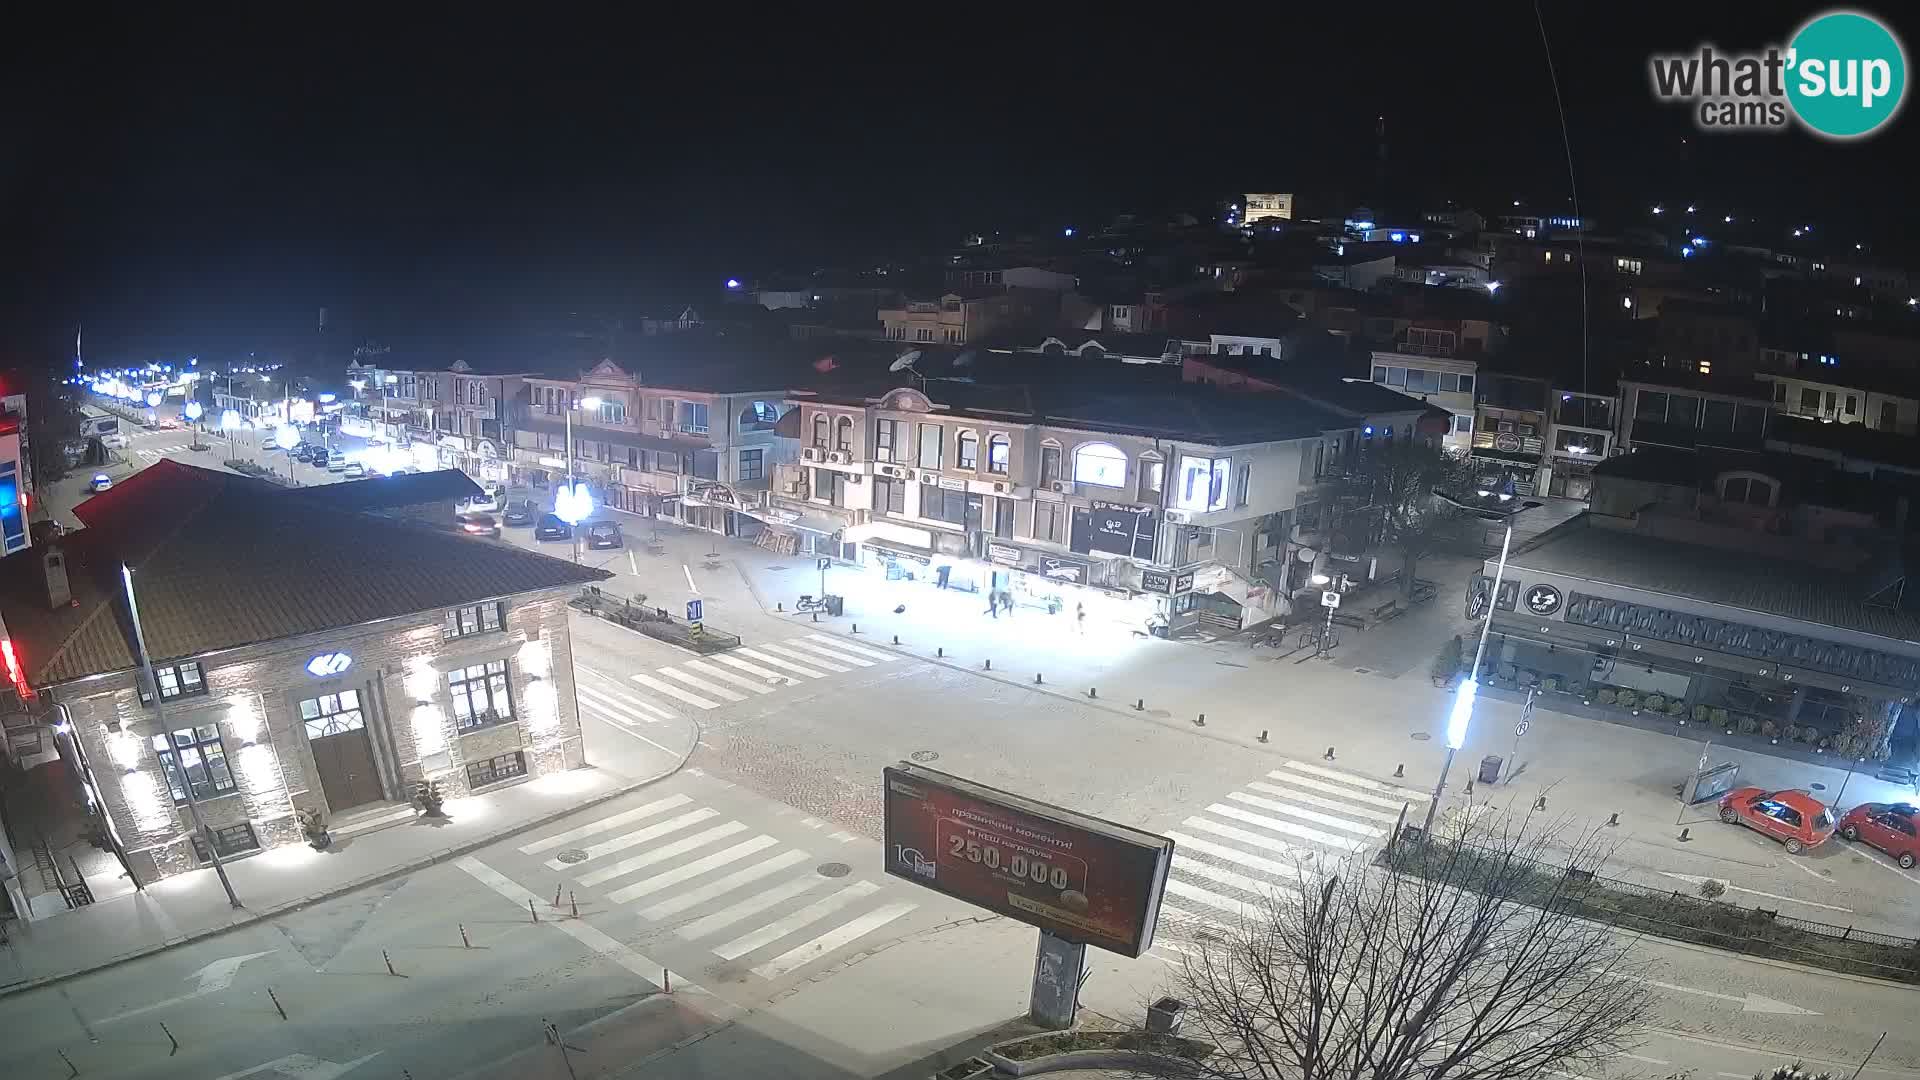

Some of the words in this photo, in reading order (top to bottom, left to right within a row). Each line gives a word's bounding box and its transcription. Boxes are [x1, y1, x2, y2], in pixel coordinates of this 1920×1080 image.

[952, 808, 1013, 832] празнични
[1015, 828, 1073, 850] моменти!
[978, 832, 1000, 844] КЕШ
[949, 834, 1068, 890] 250.000
